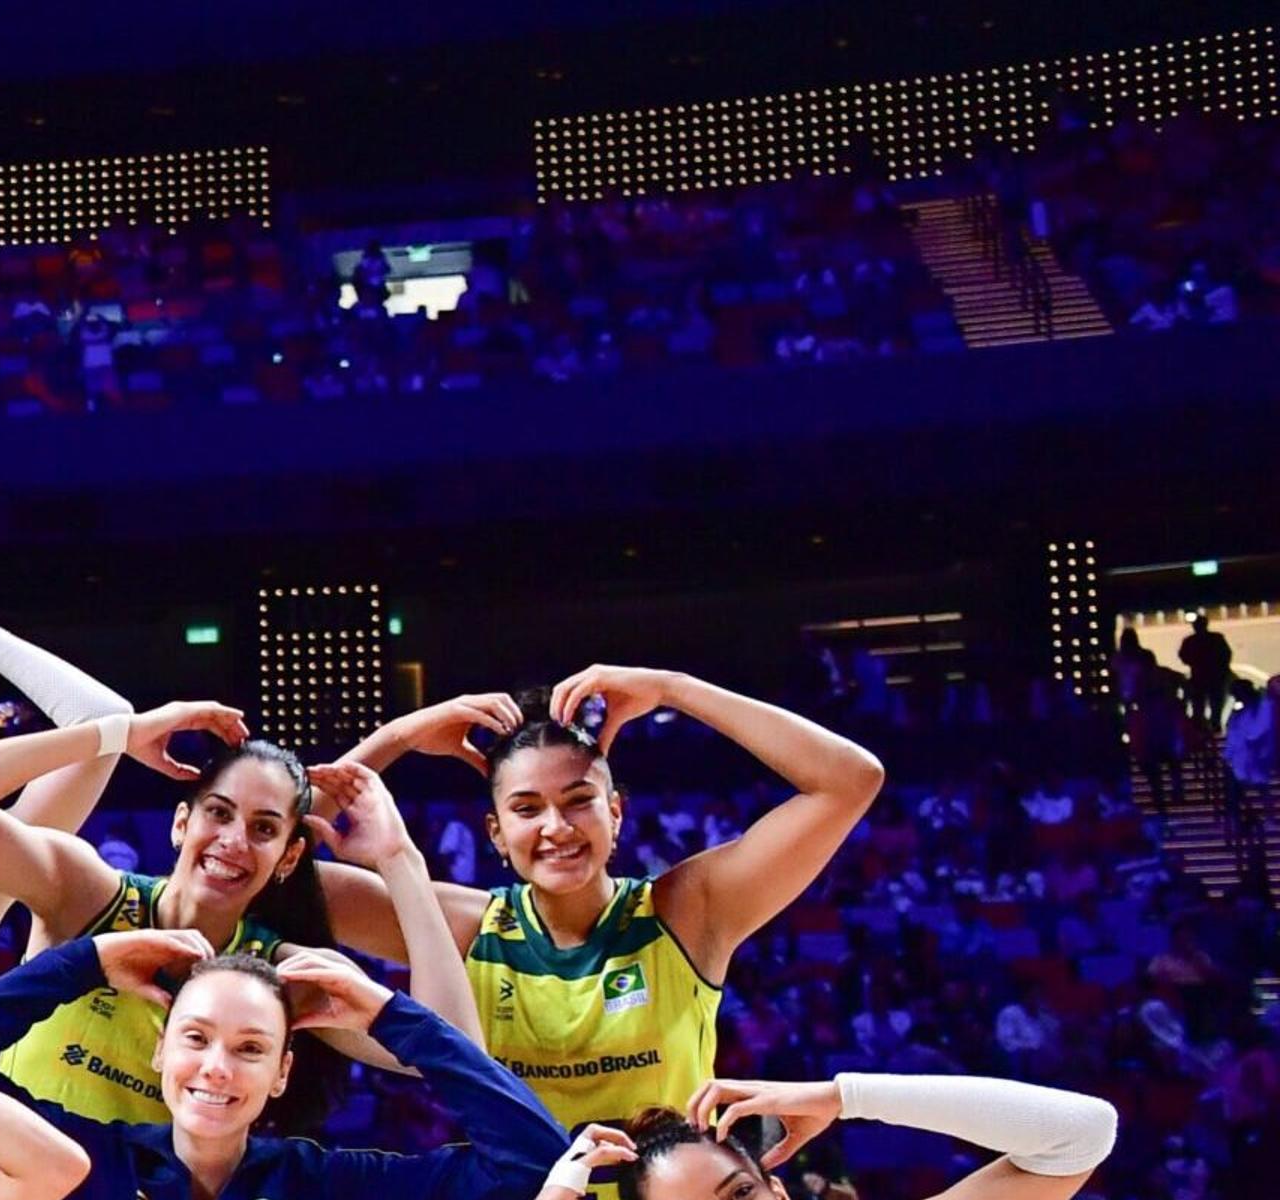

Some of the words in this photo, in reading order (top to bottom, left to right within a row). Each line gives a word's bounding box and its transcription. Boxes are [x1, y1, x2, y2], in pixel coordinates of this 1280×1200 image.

[87, 1056, 144, 1093] BANCO
[512, 1060, 571, 1079] BANCO
[574, 1060, 598, 1077] DO
[601, 1050, 662, 1073] BRASIL
